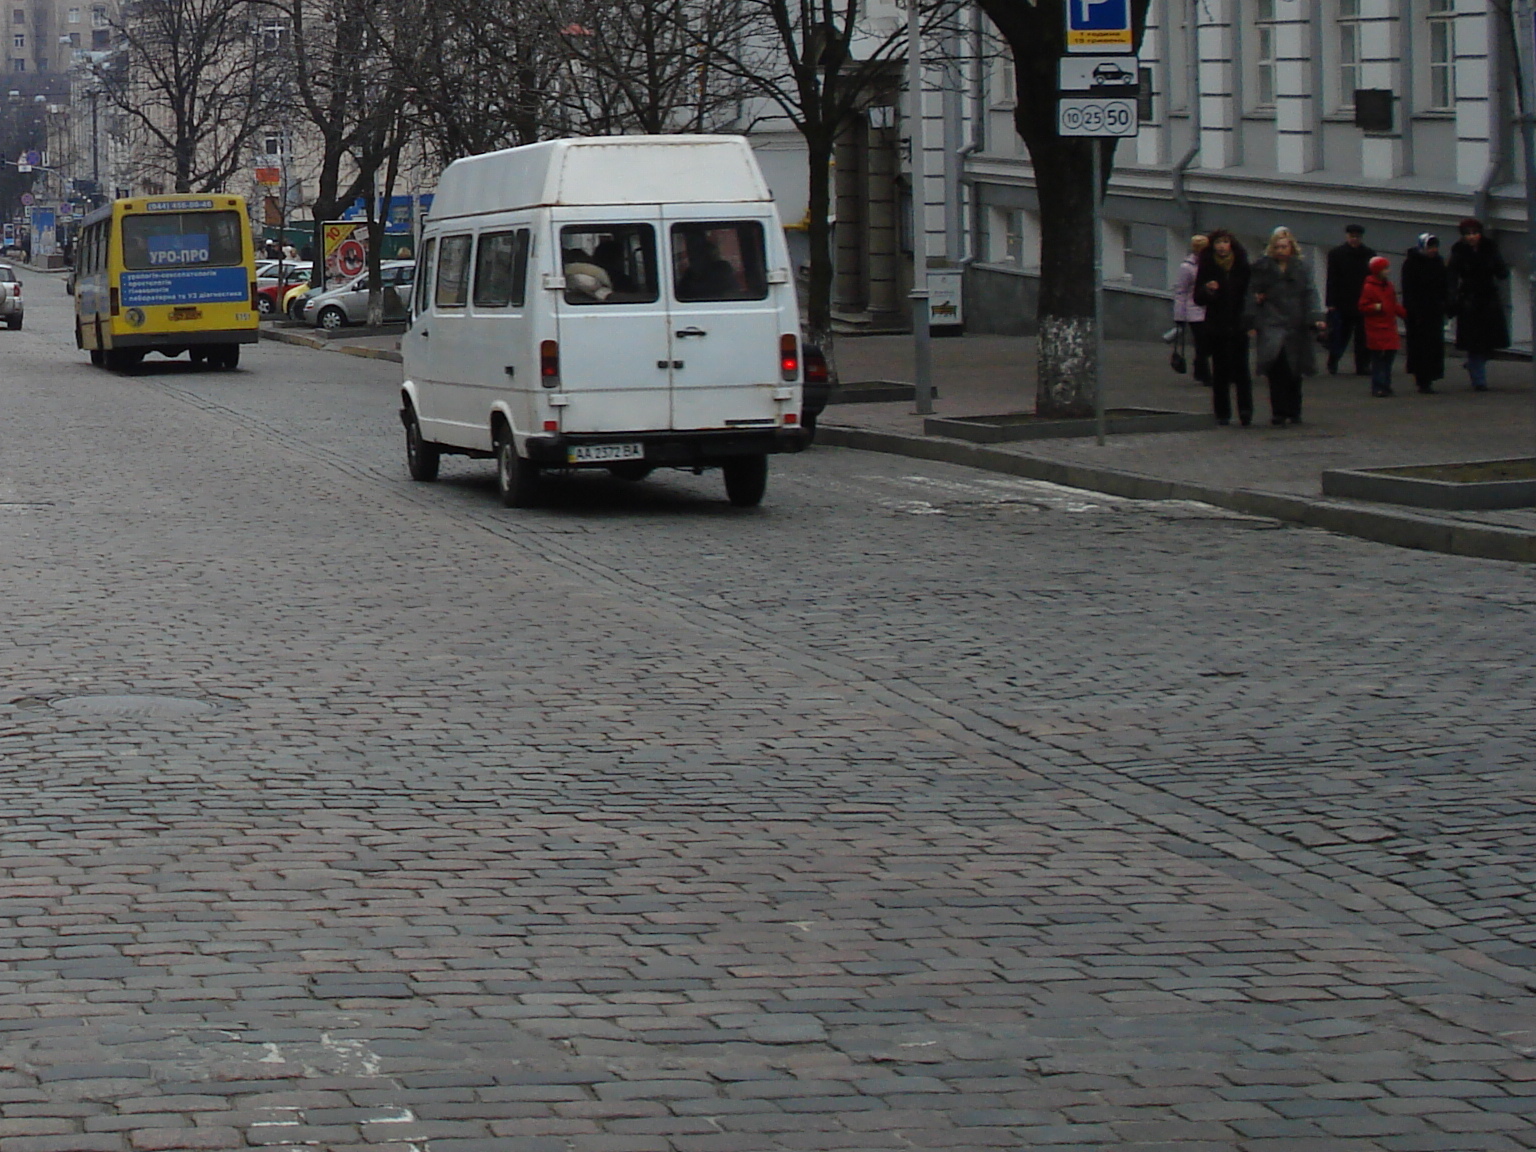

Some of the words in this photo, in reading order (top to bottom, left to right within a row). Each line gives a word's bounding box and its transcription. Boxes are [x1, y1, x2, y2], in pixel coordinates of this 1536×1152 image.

[1067, 113, 1079, 124] 10
[1084, 112, 1102, 124] 25
[1107, 109, 1129, 126] 50
[326, 227, 340, 241] 10
[149, 249, 209, 263] УРО-ПРО
[576, 447, 592, 459] AA
[595, 446, 621, 459] 2372
[624, 445, 640, 457] BA
